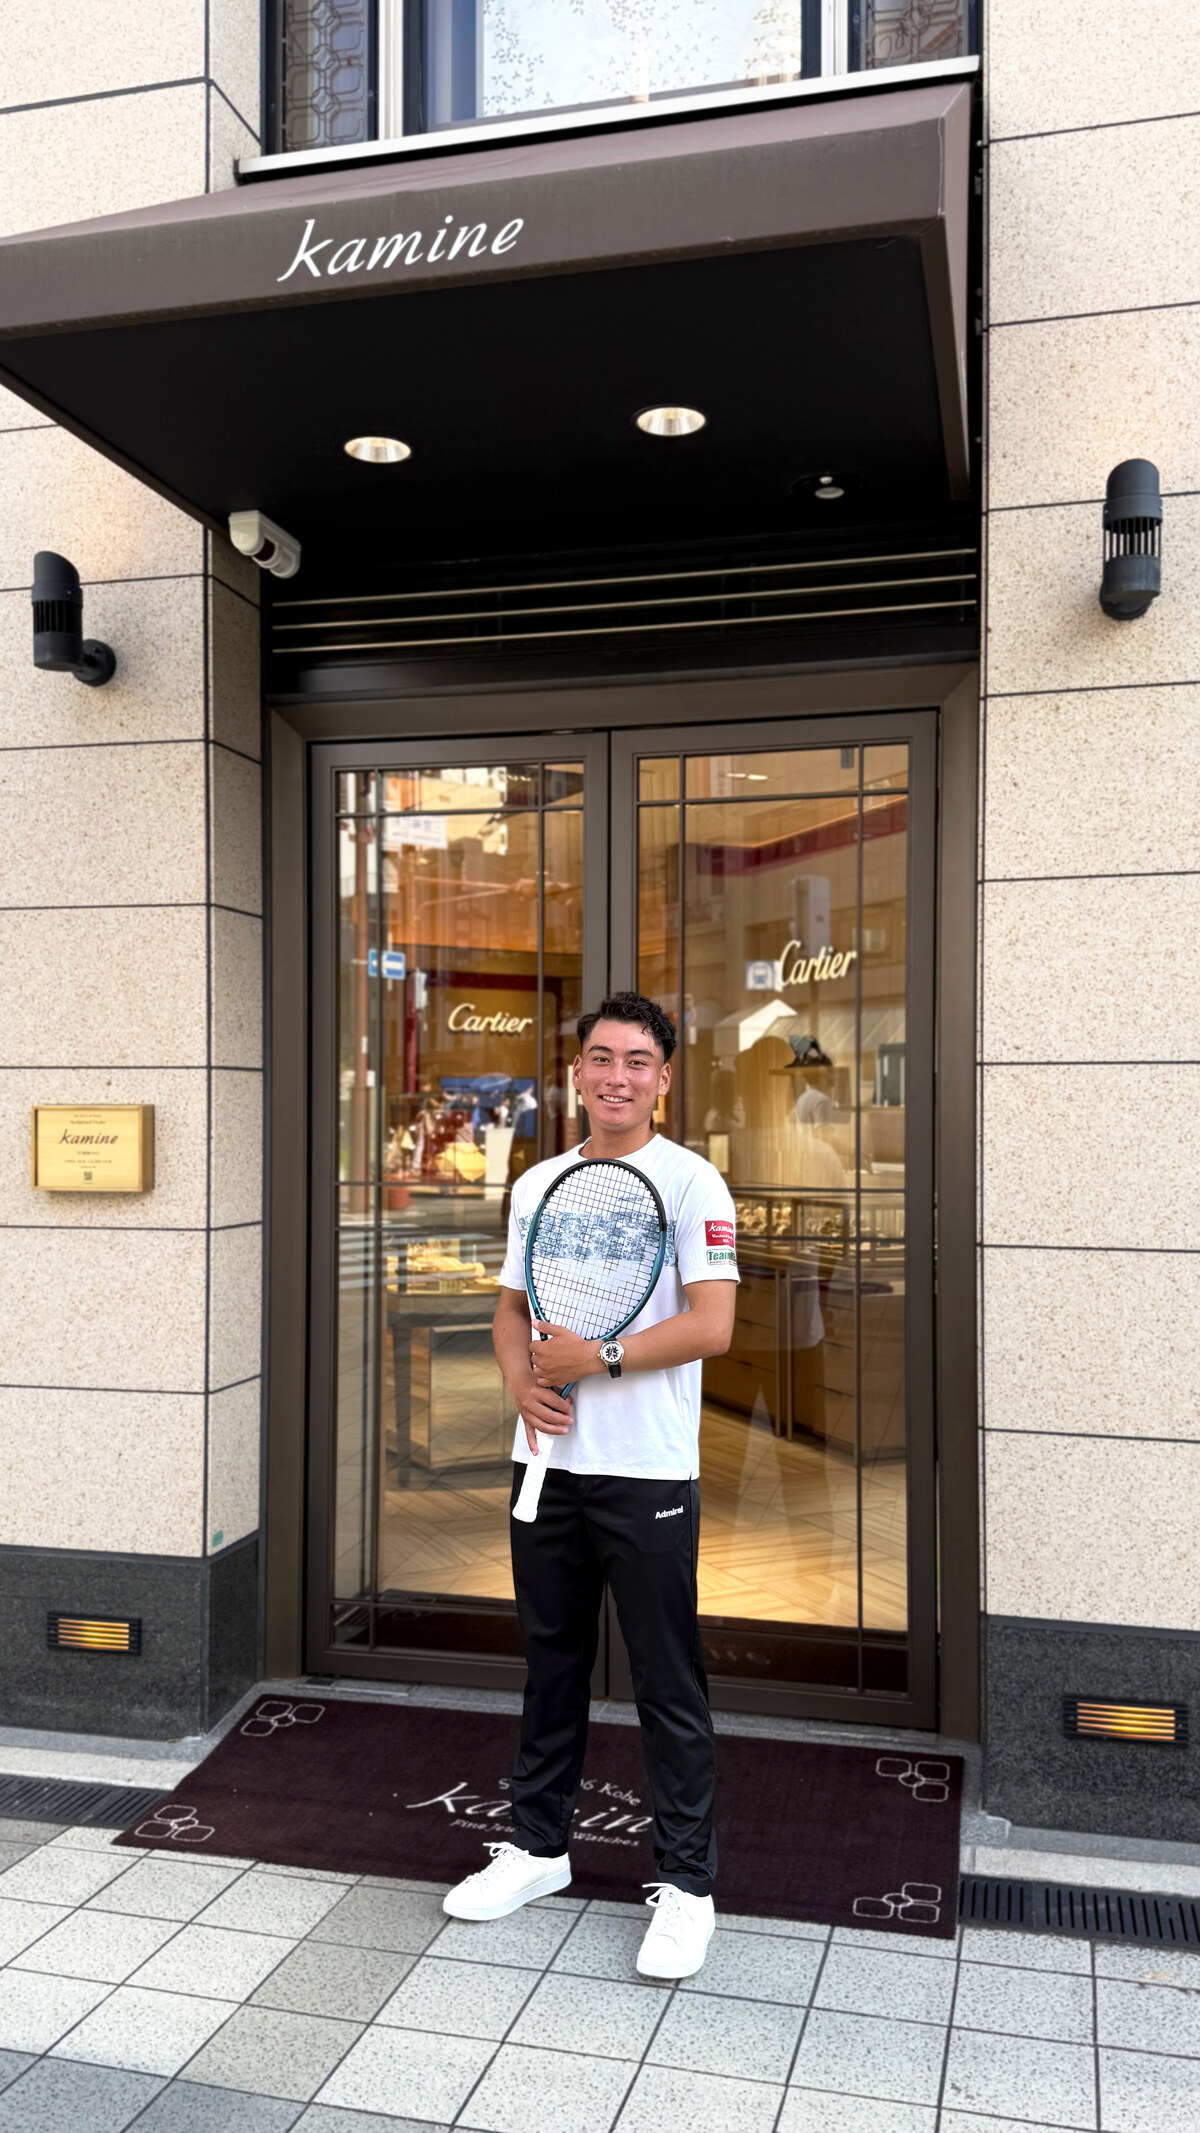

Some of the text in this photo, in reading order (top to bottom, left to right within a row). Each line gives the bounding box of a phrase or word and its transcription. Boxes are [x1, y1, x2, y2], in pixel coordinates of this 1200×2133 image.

[276, 214, 525, 282] kamine
[780, 939, 858, 987] Cartier
[448, 1002, 534, 1033] Cartier
[57, 1128, 119, 1145] kamine
[655, 1504, 684, 1520] Admiral
[598, 1782, 642, 1806] Kobe
